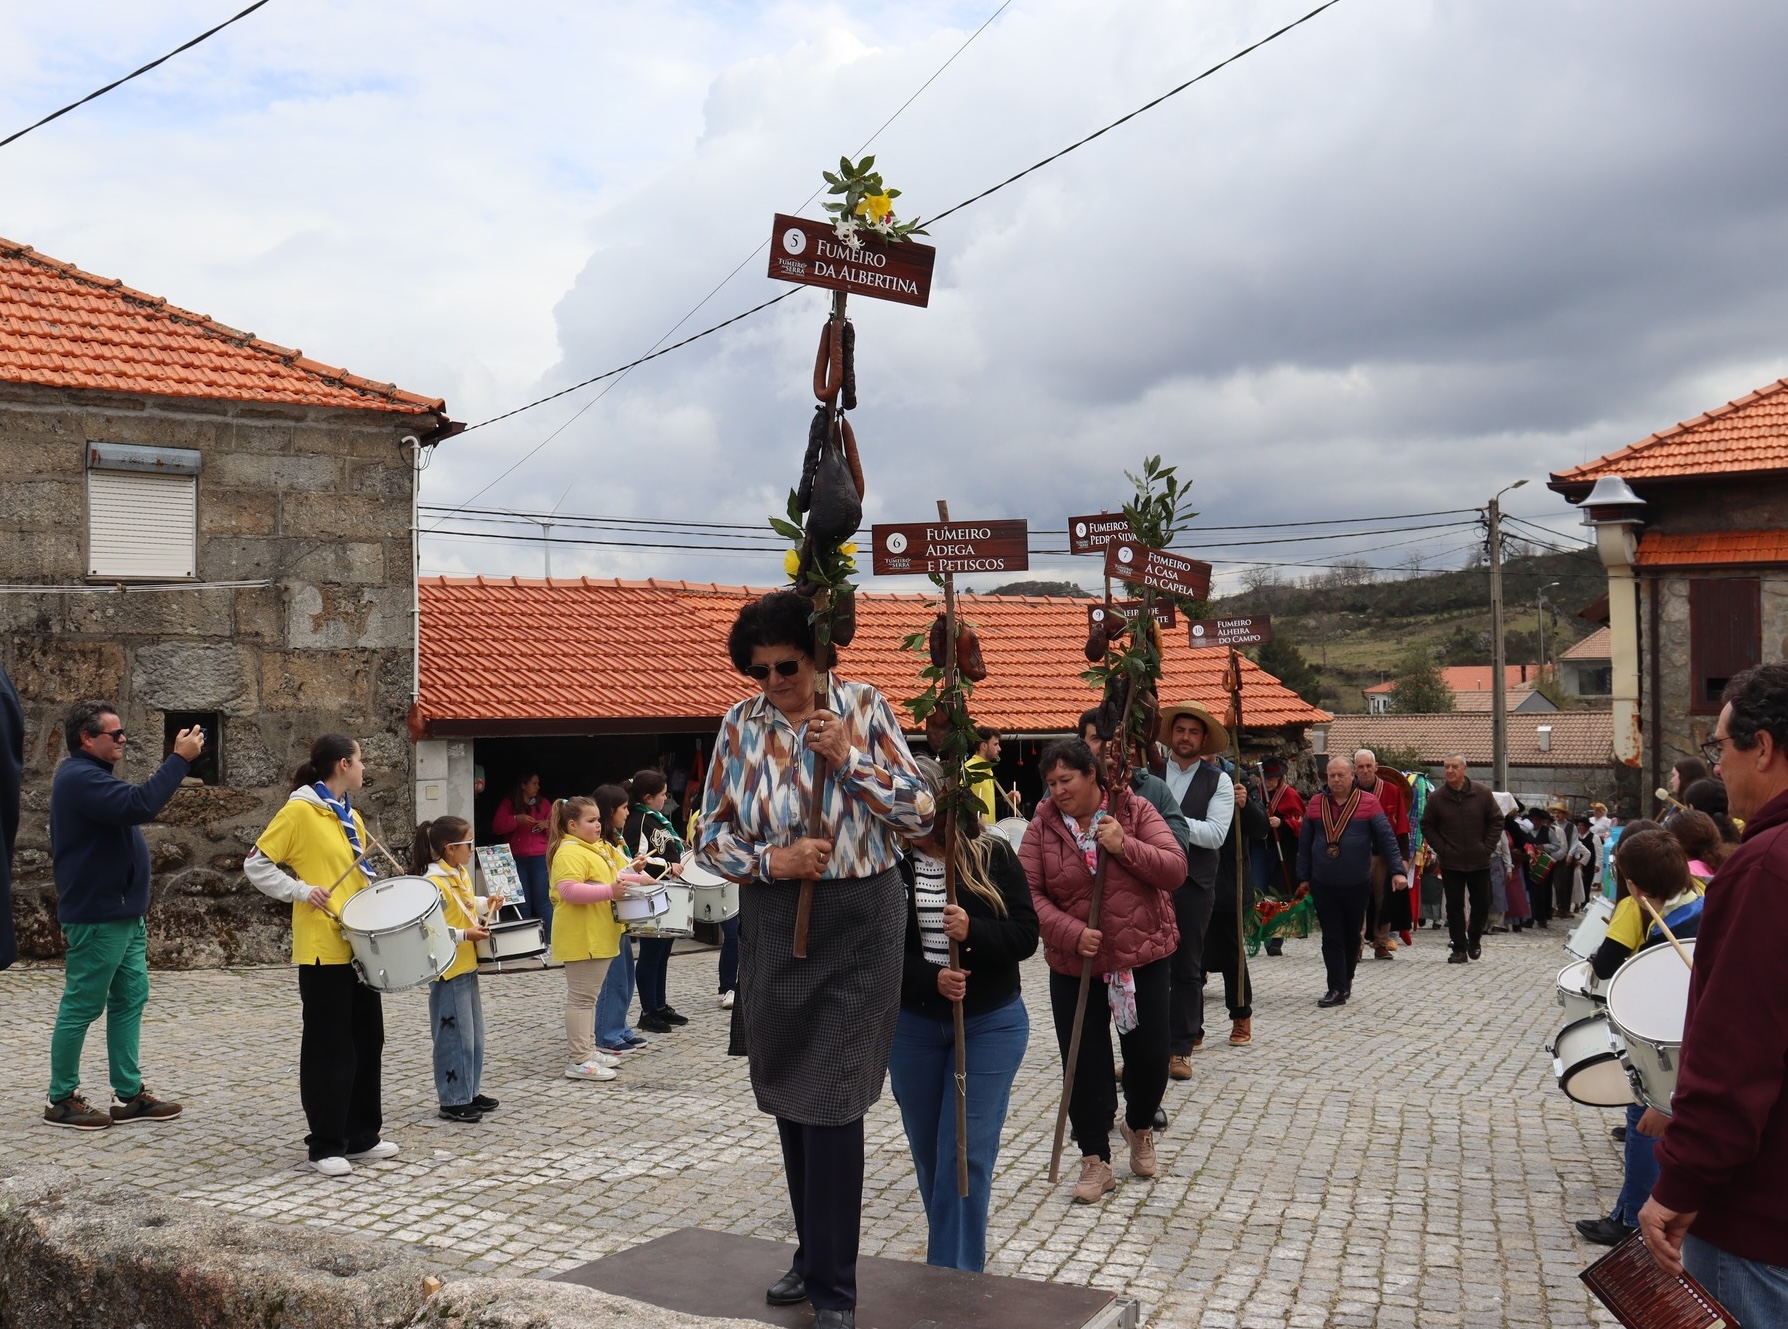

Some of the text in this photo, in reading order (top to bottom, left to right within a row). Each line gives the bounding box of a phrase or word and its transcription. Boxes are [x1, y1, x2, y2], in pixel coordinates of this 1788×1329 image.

[790, 234, 799, 248] 5
[816, 239, 886, 268] FUMEIRO
[813, 261, 919, 295] DA ALBERTINA
[1089, 520, 1129, 533] FUMEIROS
[925, 527, 991, 541] FUMEIRO
[893, 536, 901, 548] 6
[925, 544, 975, 557] ADEGA
[1123, 549, 1129, 559] 7
[939, 558, 1005, 572] PETISCOS
[1148, 551, 1191, 572] FUMEIRO
[1144, 563, 1153, 574] A
[1154, 565, 1179, 581] CASA
[1144, 575, 1194, 597] DA CAPELA
[1217, 619, 1252, 628] FUMEIRO
[1217, 628, 1250, 637] ALHEIRA
[1218, 634, 1261, 645] DO CAMPO
